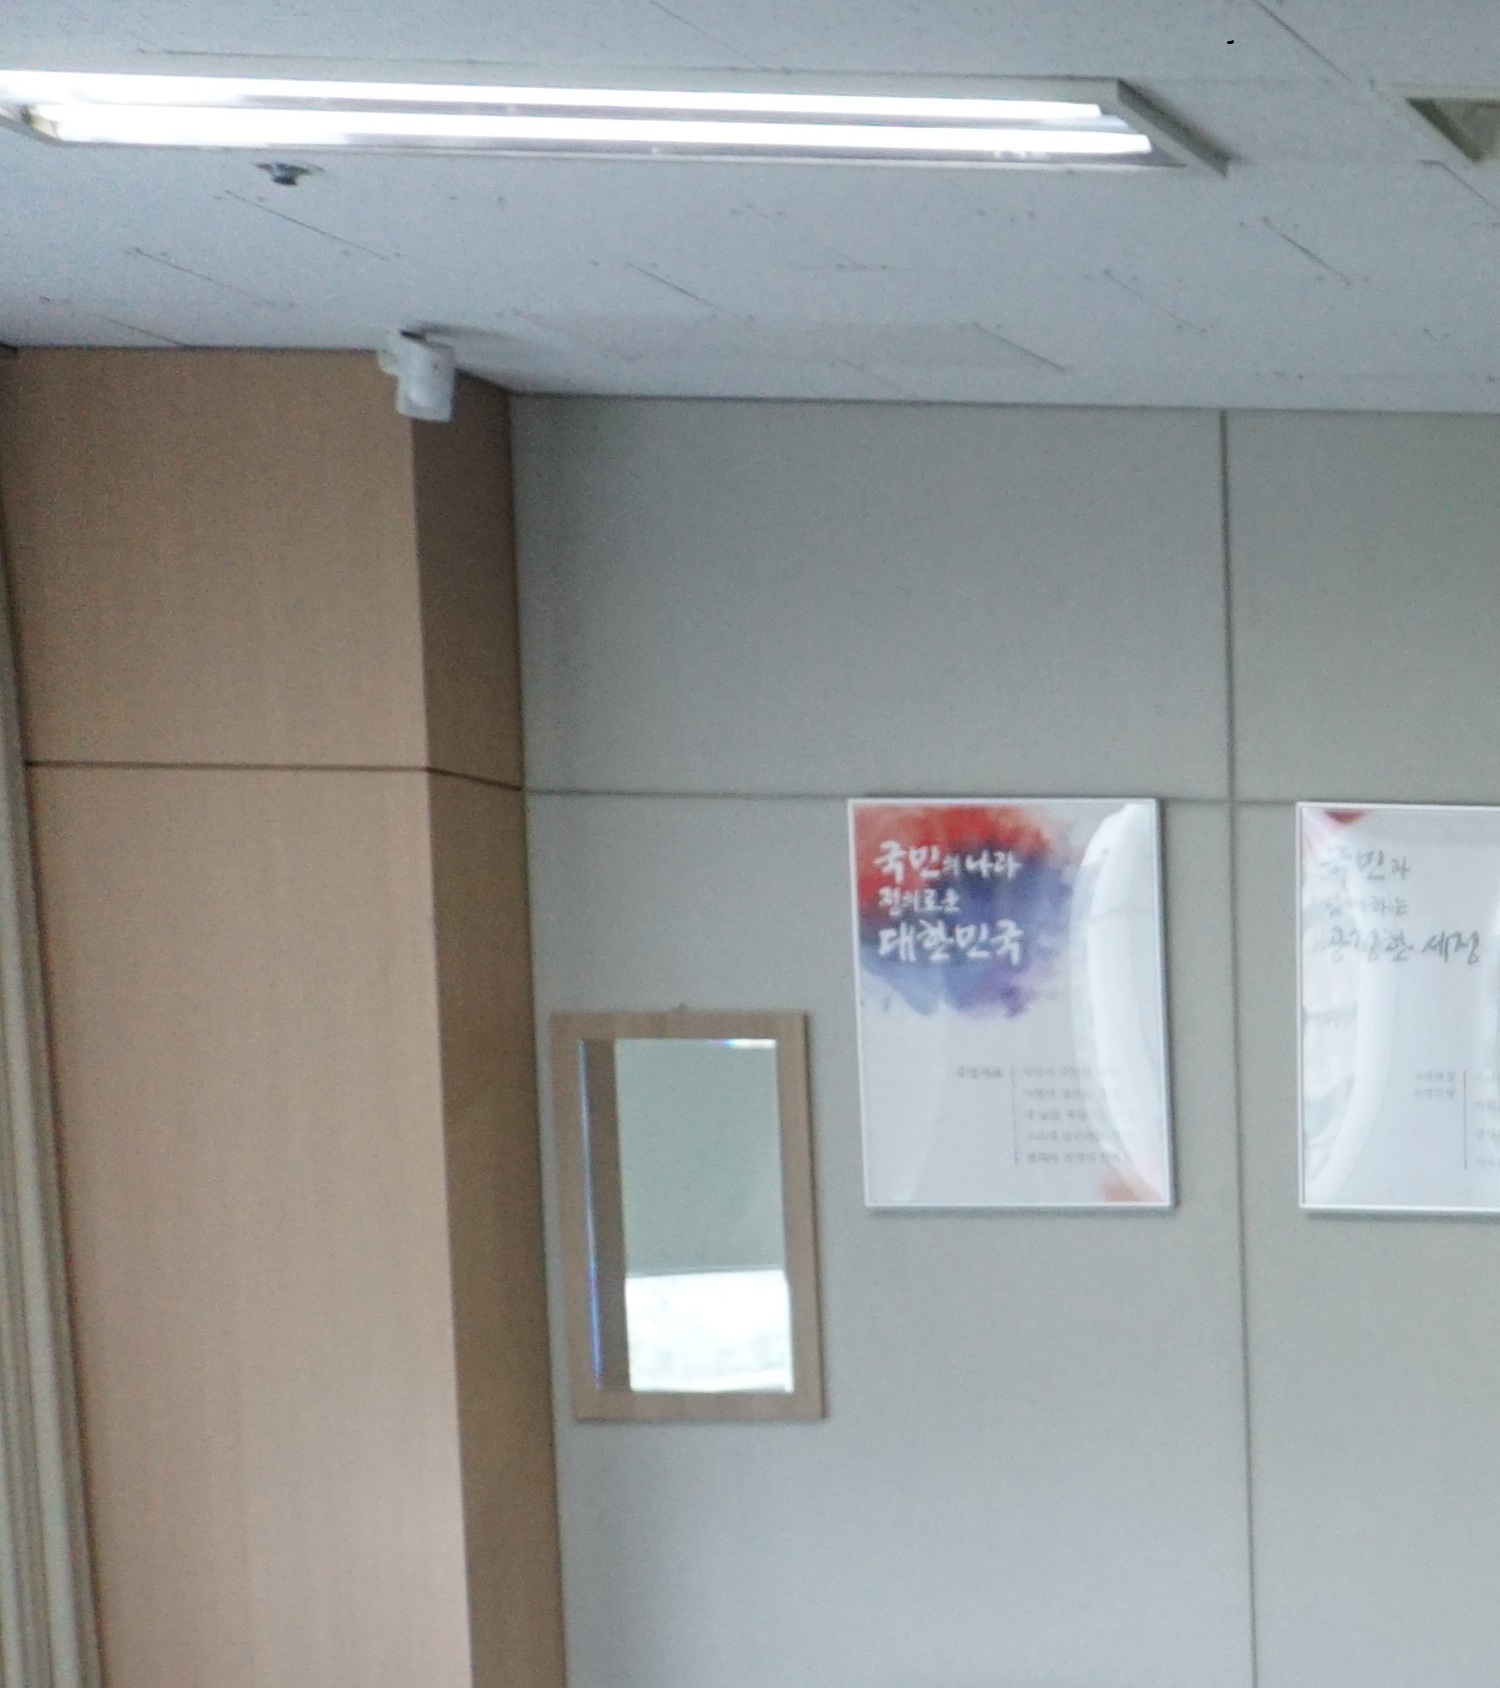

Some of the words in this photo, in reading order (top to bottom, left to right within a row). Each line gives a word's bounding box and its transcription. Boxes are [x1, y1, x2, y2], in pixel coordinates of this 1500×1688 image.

[873, 840, 961, 884] 국민의
[965, 849, 1024, 880] 나라
[879, 919, 1024, 966] 대한민국
[1421, 929, 1480, 966] 세정
